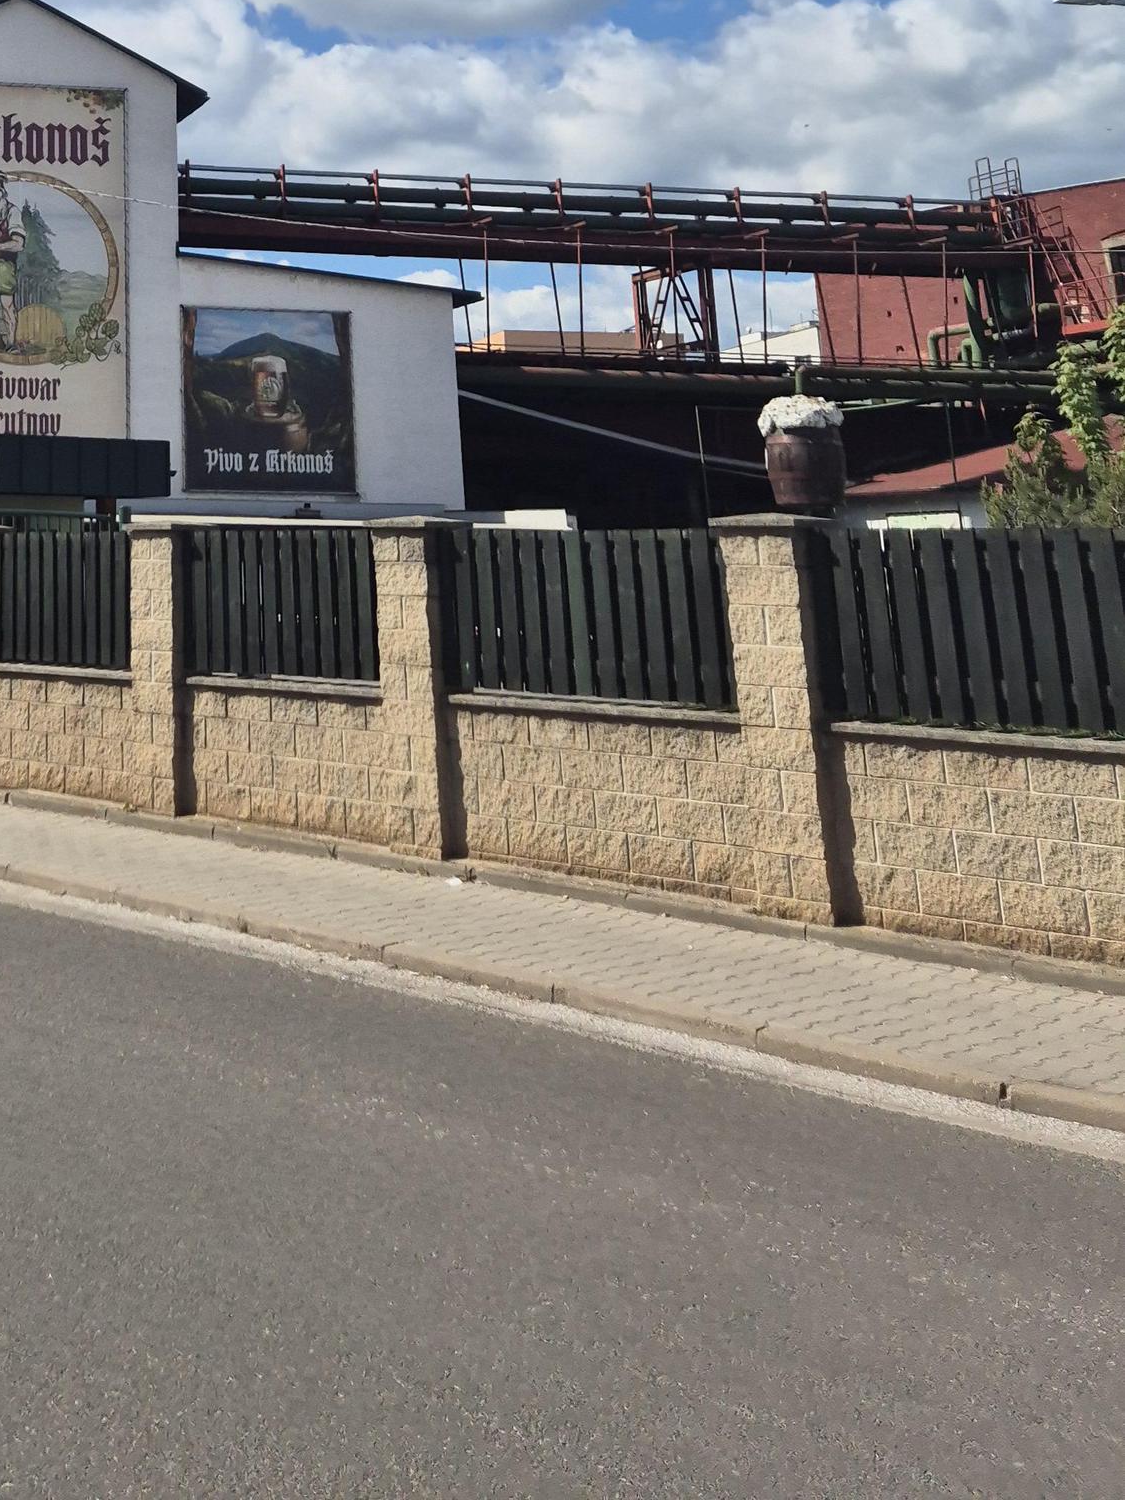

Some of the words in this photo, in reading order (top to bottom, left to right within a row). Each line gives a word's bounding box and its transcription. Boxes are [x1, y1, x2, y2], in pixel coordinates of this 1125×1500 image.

[203, 447, 243, 474] Pivo
[248, 451, 260, 473] z
[265, 449, 335, 474] Krkonoš
